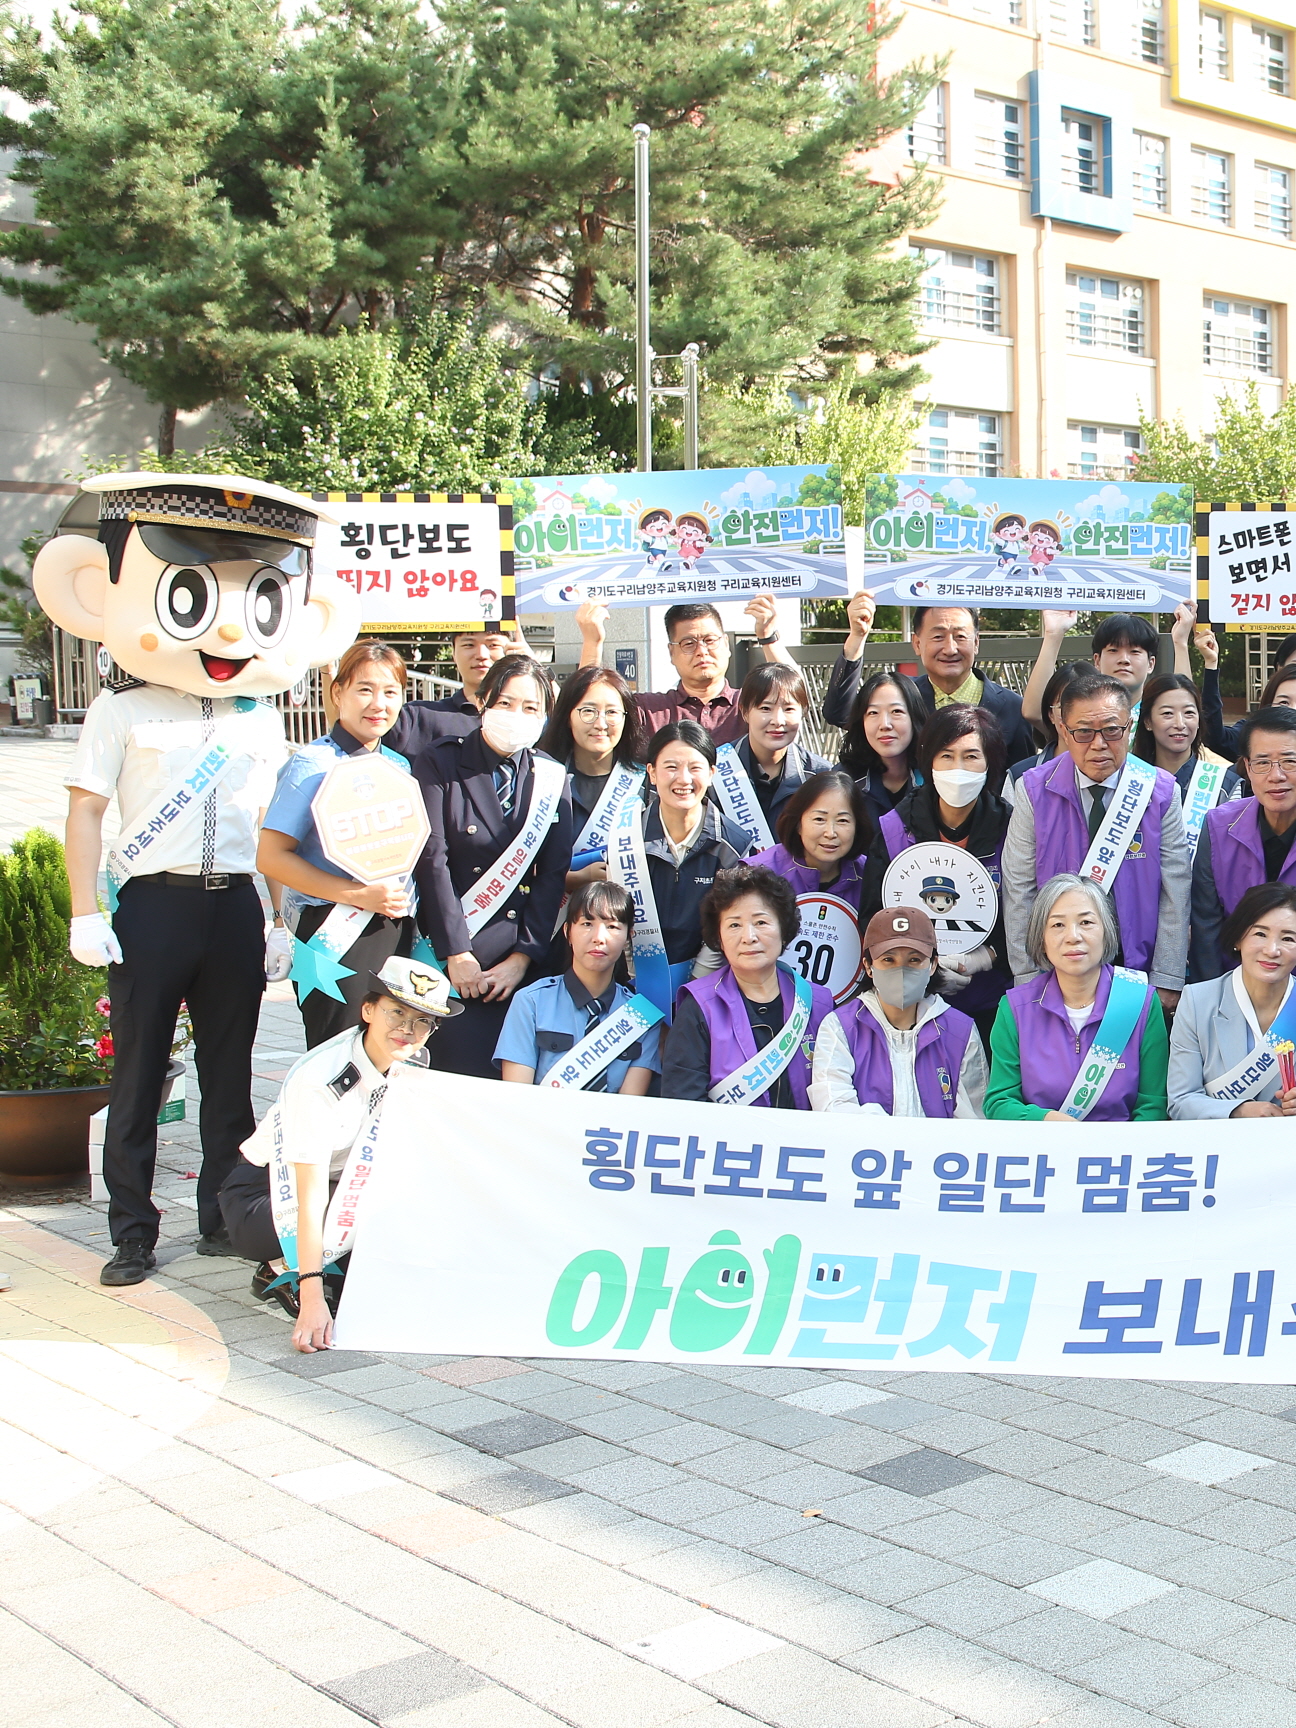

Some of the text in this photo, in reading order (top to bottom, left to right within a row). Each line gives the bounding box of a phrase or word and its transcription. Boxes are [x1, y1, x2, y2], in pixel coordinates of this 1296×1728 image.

[340, 522, 473, 560] 횡단보도
[721, 505, 842, 546] 안전먼저!
[1073, 521, 1188, 557] 안전먼저!
[1217, 520, 1293, 556] 스마트폰
[403, 569, 480, 598] 않아요
[586, 573, 802, 598] 경기도구리남양주교육지원청 구리교육지원센터
[1228, 552, 1293, 586] 보면서
[936, 582, 1147, 602] 경기도구리남양주교육지원청 구리교육지원센터
[1230, 592, 1273, 616] 걷지
[99, 650, 109, 668] 10
[624, 664, 636, 678] 40
[715, 760, 755, 826] 횡단보도
[1186, 762, 1221, 830] 아이먼저
[122, 789, 193, 862] 보내주세요
[330, 797, 414, 842] STOP
[1104, 779, 1144, 846] 횡단보도
[500, 848, 528, 881] 일단
[1096, 846, 1116, 866] 앞
[899, 859, 922, 881] 아이
[929, 856, 957, 869] 내가
[966, 871, 987, 910] 지킨다
[811, 930, 825, 940] 제한
[826, 932, 840, 943] 준수
[892, 917, 911, 932] G
[793, 939, 835, 987] 30
[578, 1016, 633, 1070] 횡단보도
[742, 1012, 804, 1092] 아이먼저
[273, 1110, 294, 1203] 보내주세요
[581, 1126, 1220, 1213] 횡단보도 앞 일단 멈춤!
[348, 1164, 372, 1190] 일단
[545, 1229, 1038, 1362] 아이먼저
